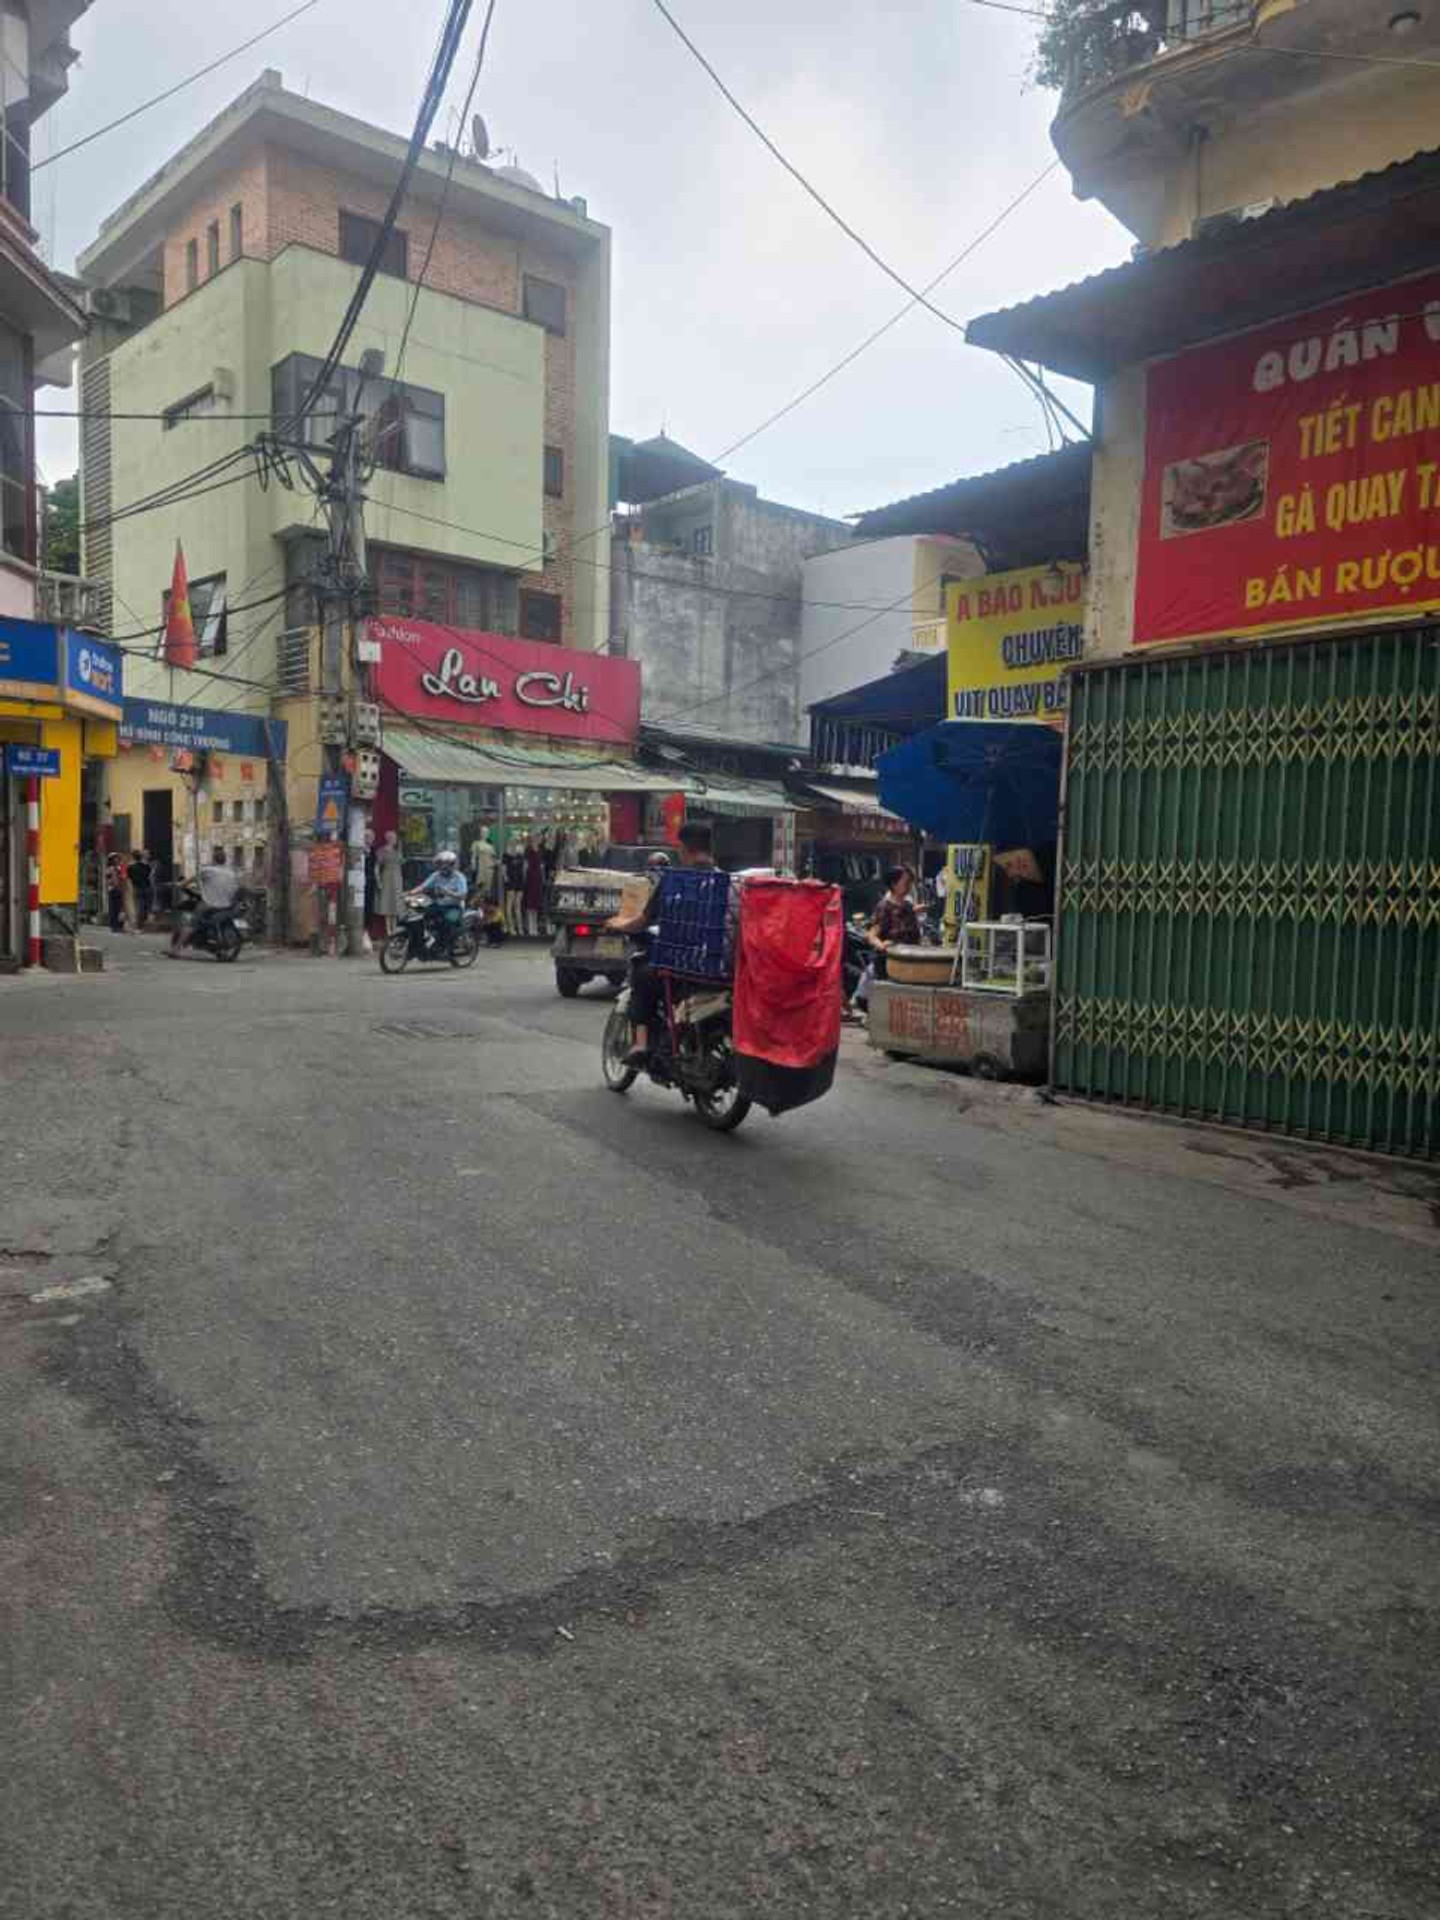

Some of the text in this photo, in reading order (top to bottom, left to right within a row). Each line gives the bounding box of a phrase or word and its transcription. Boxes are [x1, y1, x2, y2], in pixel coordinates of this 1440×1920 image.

[1253, 317, 1400, 391] QUÁN
[1298, 393, 1361, 459] TIẾT
[1275, 483, 1315, 538] GÀ
[1326, 468, 1407, 532] QUAY
[1245, 564, 1321, 609] BÁN
[422, 648, 590, 712] Lan Chi
[988, 682, 1037, 718] QUAY
